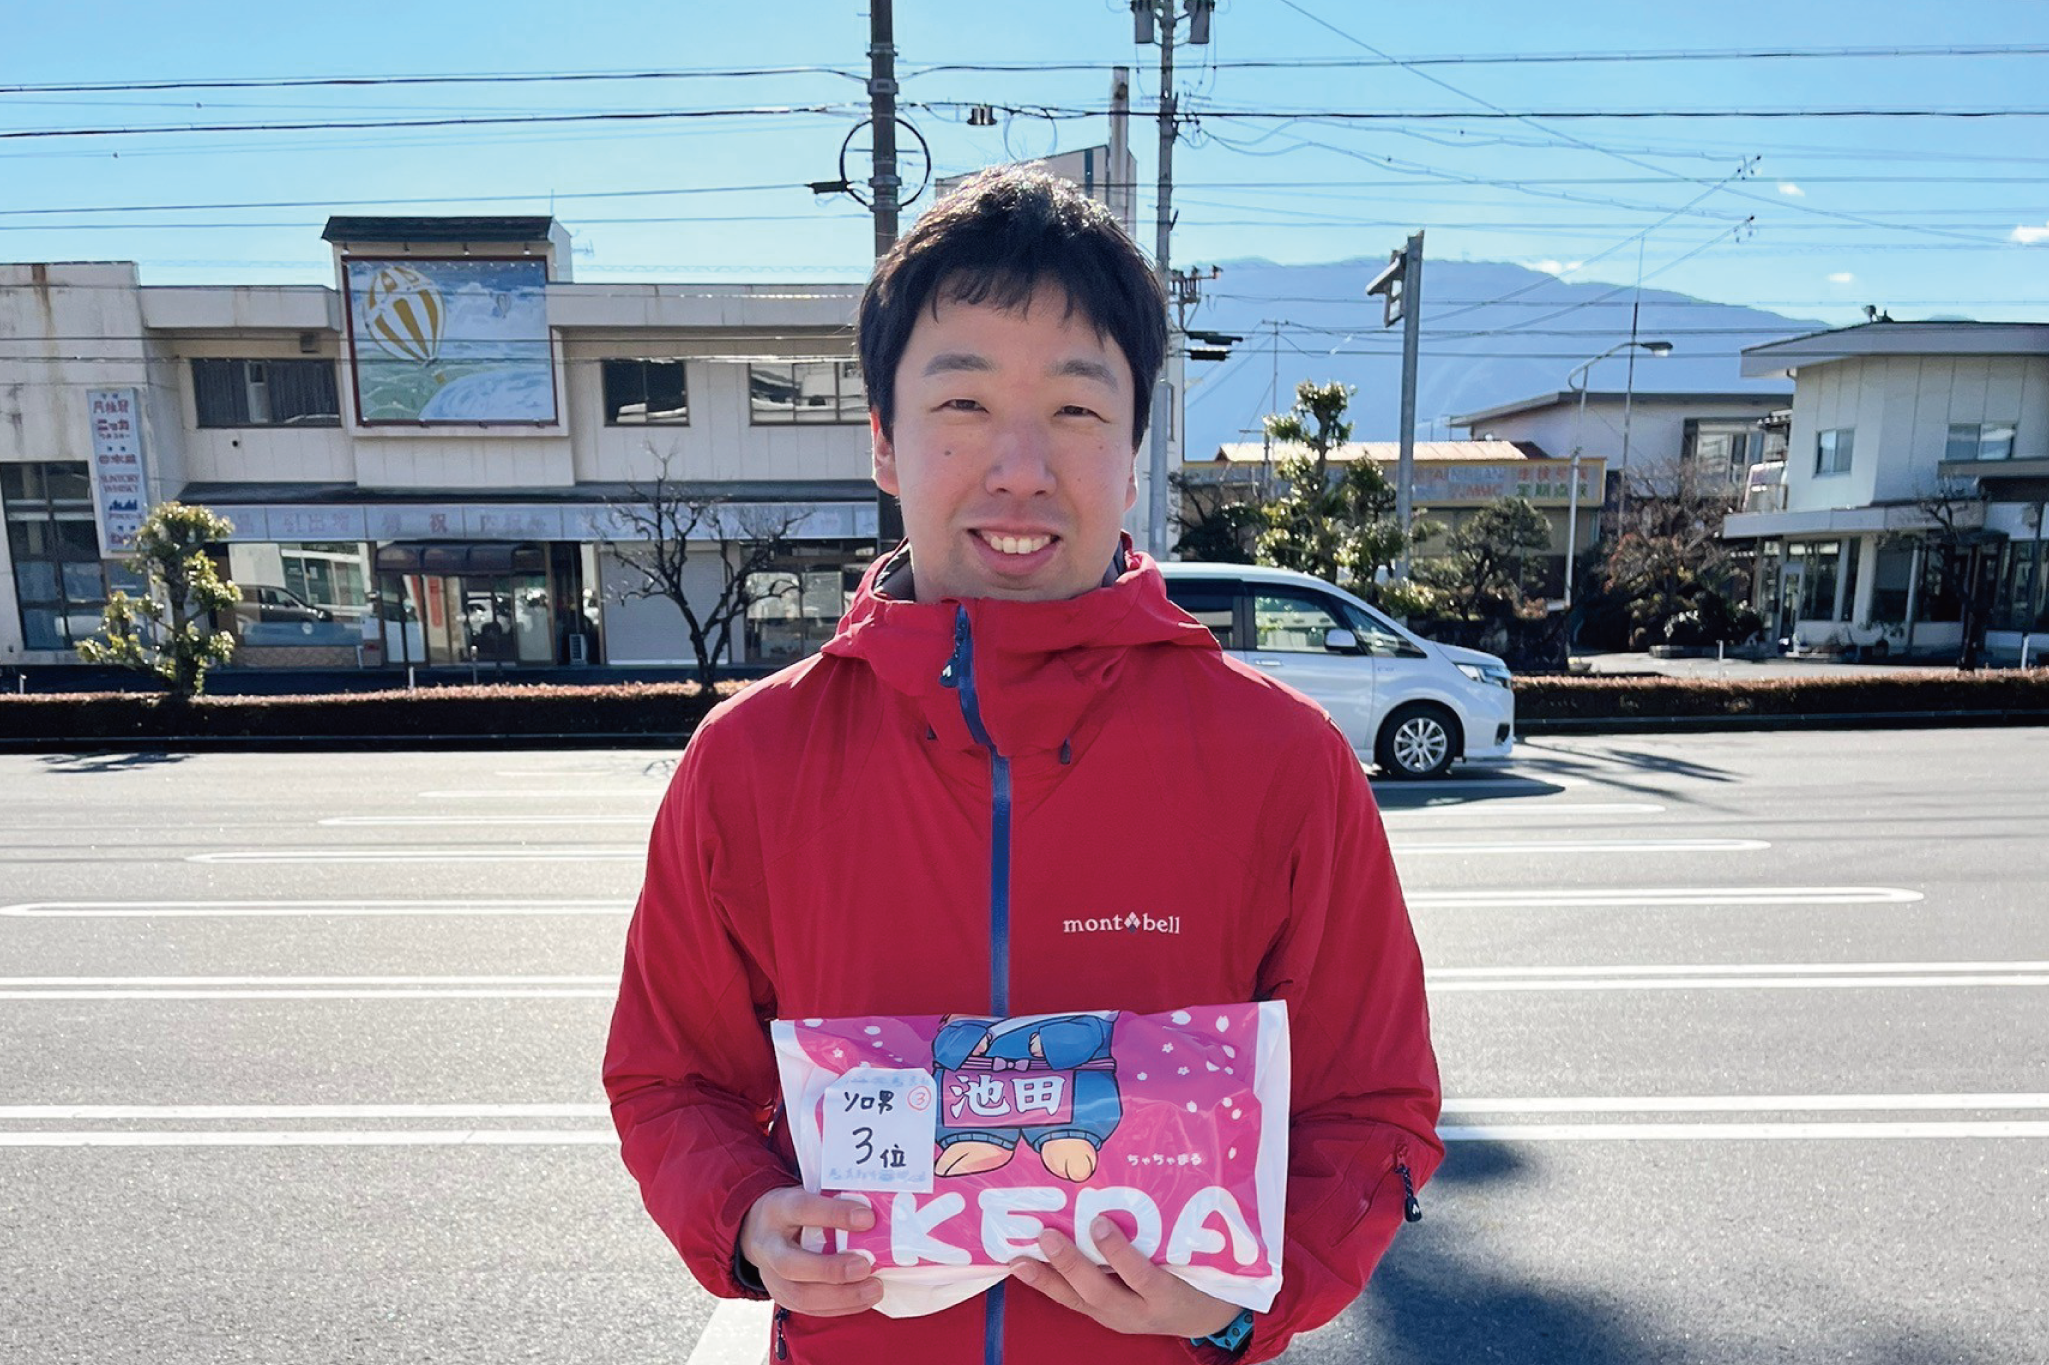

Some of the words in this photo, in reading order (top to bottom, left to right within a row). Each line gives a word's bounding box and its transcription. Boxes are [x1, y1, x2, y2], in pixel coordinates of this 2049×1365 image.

[844, 1090, 895, 1115] ソロ男
[949, 1074, 1066, 1119] 池田
[852, 1126, 907, 1168] 3位
[1125, 1152, 1203, 1167] ちゃちゃまる
